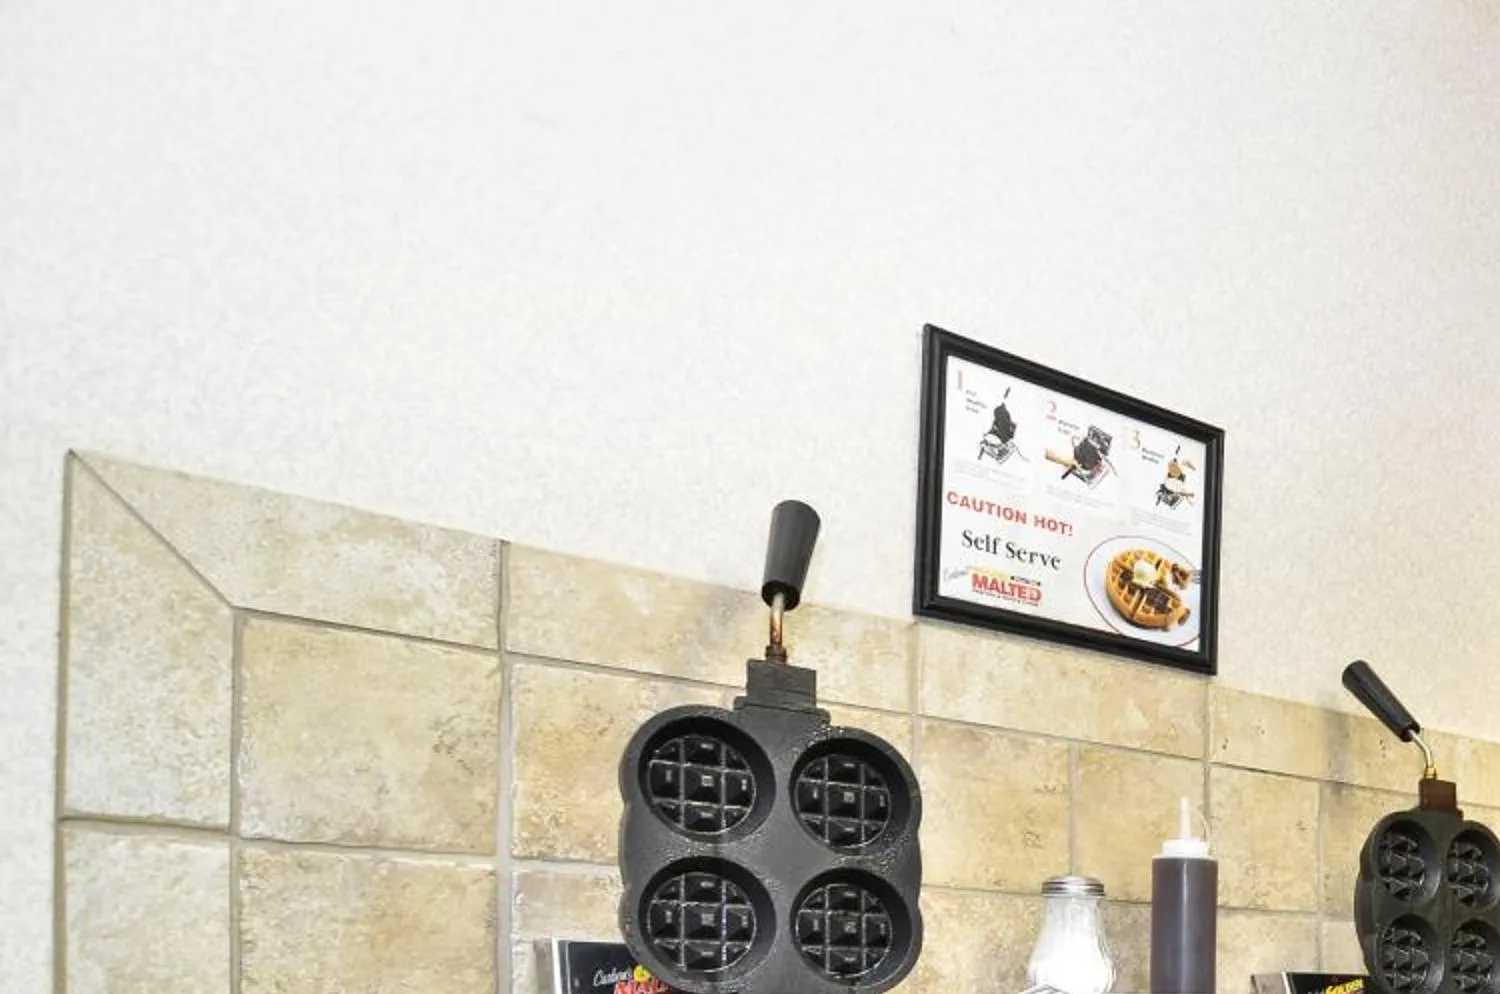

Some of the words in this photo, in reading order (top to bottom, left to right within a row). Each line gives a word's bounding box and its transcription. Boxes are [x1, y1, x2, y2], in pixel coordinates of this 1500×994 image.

[946, 490, 1028, 525] CAUTION
[1033, 514, 1073, 537] HOT!
[961, 528, 1001, 555] Self
[1005, 540, 1061, 571] Serve
[971, 573, 1042, 603] MALTED
